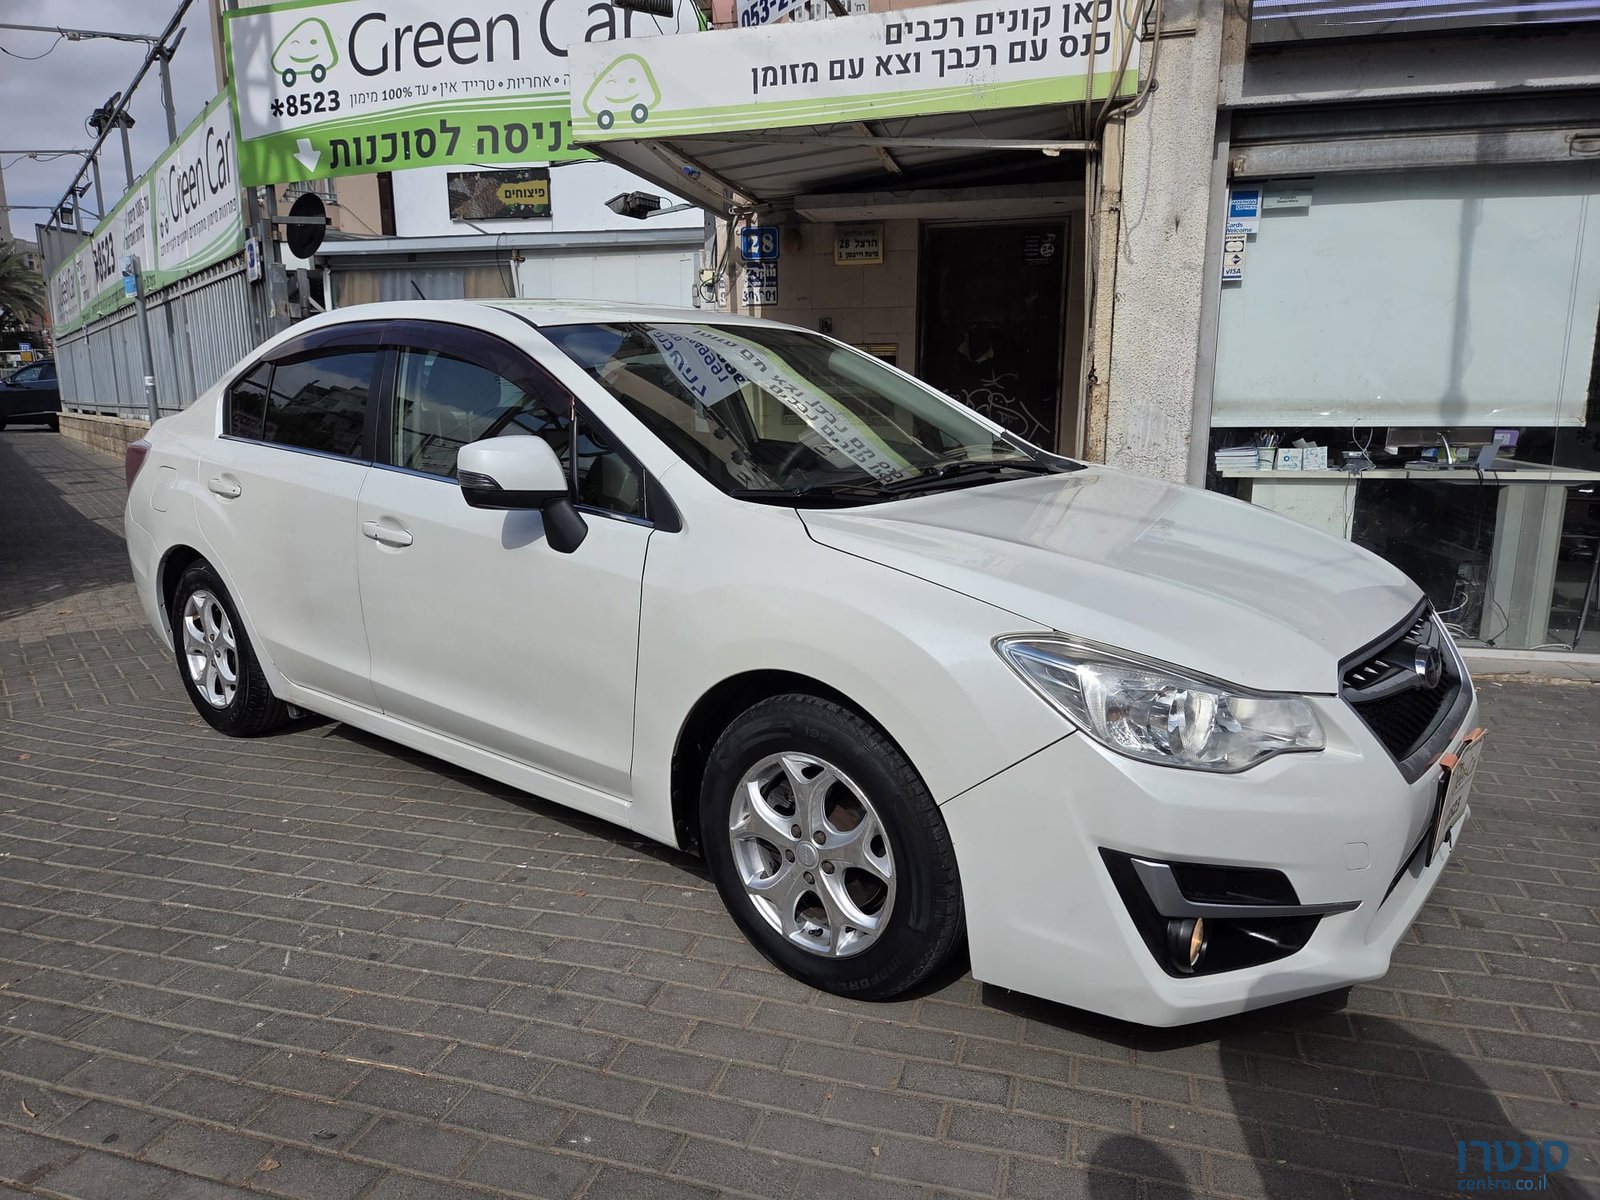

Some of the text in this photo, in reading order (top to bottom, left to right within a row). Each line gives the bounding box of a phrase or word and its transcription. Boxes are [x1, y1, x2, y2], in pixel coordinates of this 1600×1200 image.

[885, 0, 1112, 45] כאן קונים רכבים
[348, 12, 520, 77] Green
[751, 32, 1111, 95] כנס עם רכבך וצא עם מזומן
[415, 84, 429, 96] עד
[440, 81, 457, 97] אין
[462, 79, 495, 93] טרייד
[506, 75, 551, 90] אחריות
[350, 91, 378, 108] מימון
[382, 87, 413, 101] 100%
[329, 119, 574, 169] ניסה לסוכנות
[168, 126, 231, 223] Green Car
[504, 187, 545, 199] פיצוחים
[747, 233, 774, 254] 28
